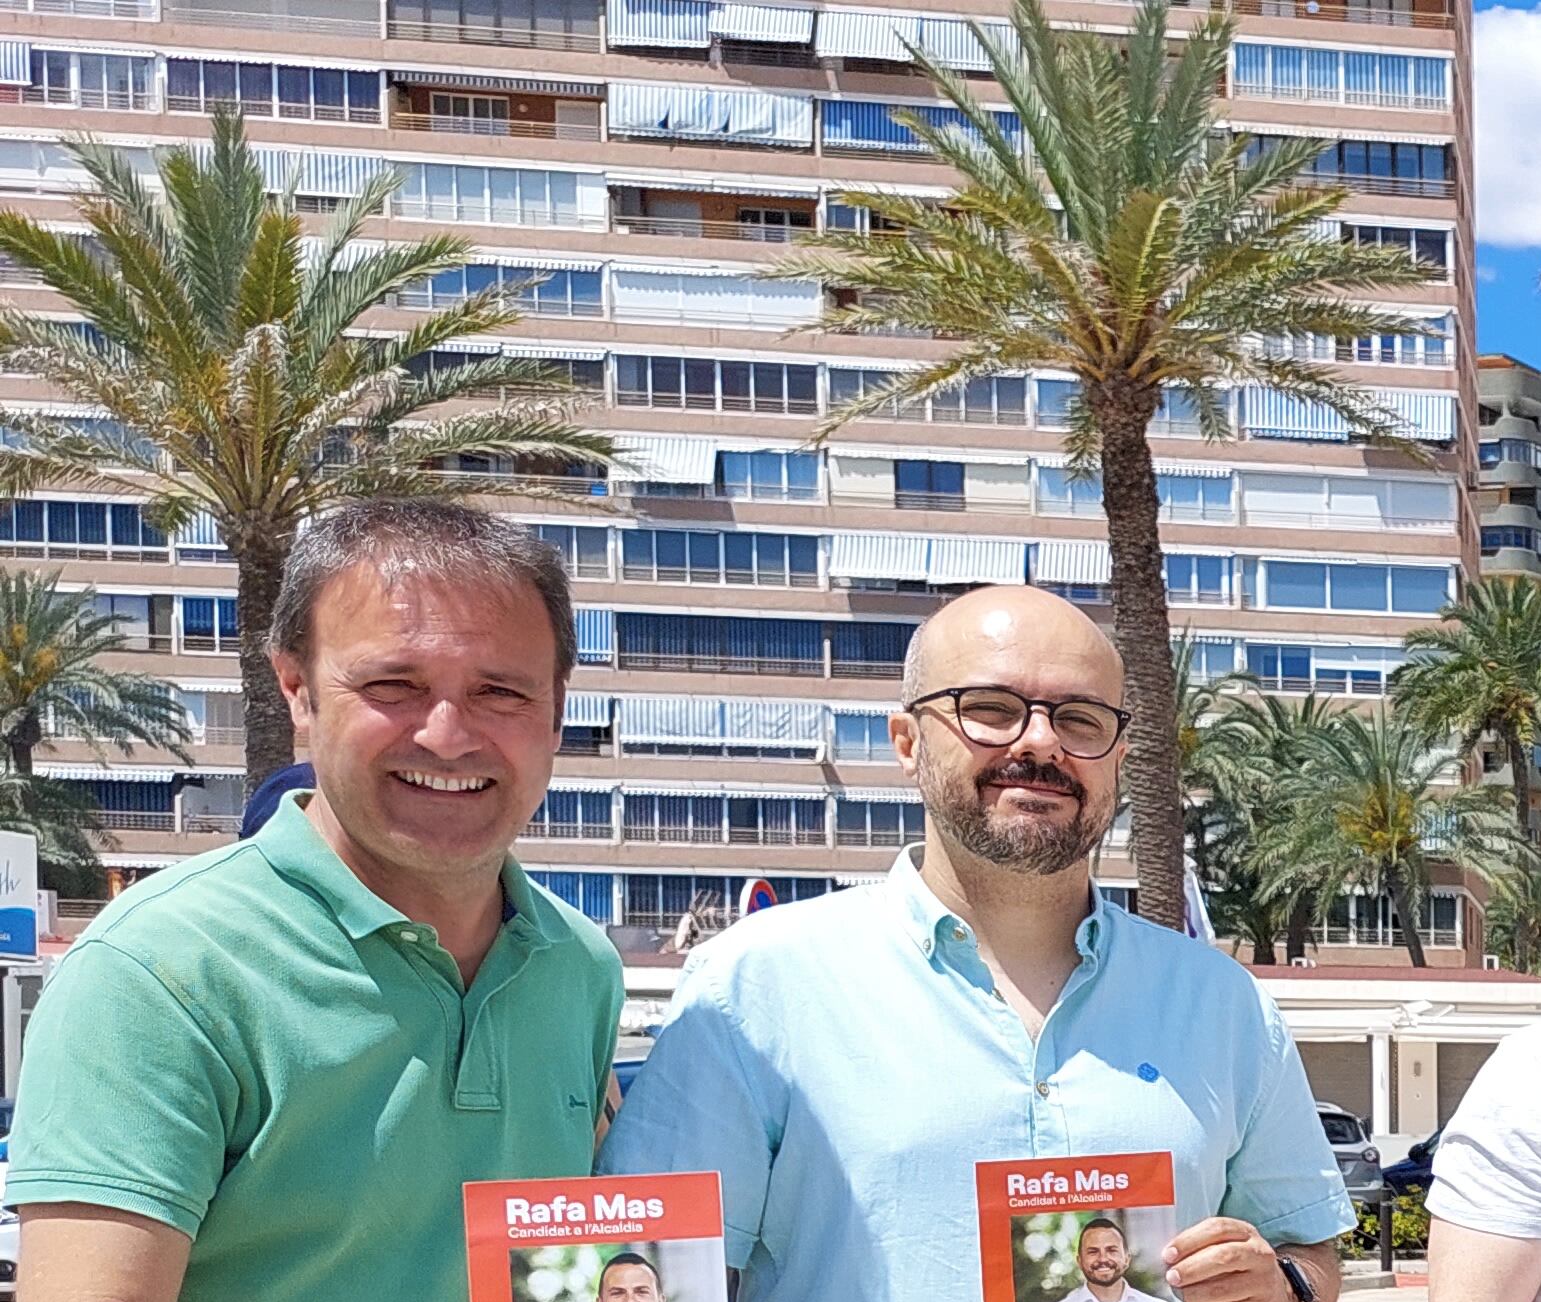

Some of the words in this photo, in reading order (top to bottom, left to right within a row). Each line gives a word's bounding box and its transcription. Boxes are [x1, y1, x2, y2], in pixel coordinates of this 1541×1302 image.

[1007, 1171, 1069, 1196] Rafa
[1074, 1169, 1129, 1192] Mas
[505, 1195, 586, 1225] Rafa
[593, 1193, 664, 1221] Mas
[1009, 1197, 1057, 1208] Candidat
[508, 1225, 572, 1239] Candidat
[574, 1227, 582, 1236] a
